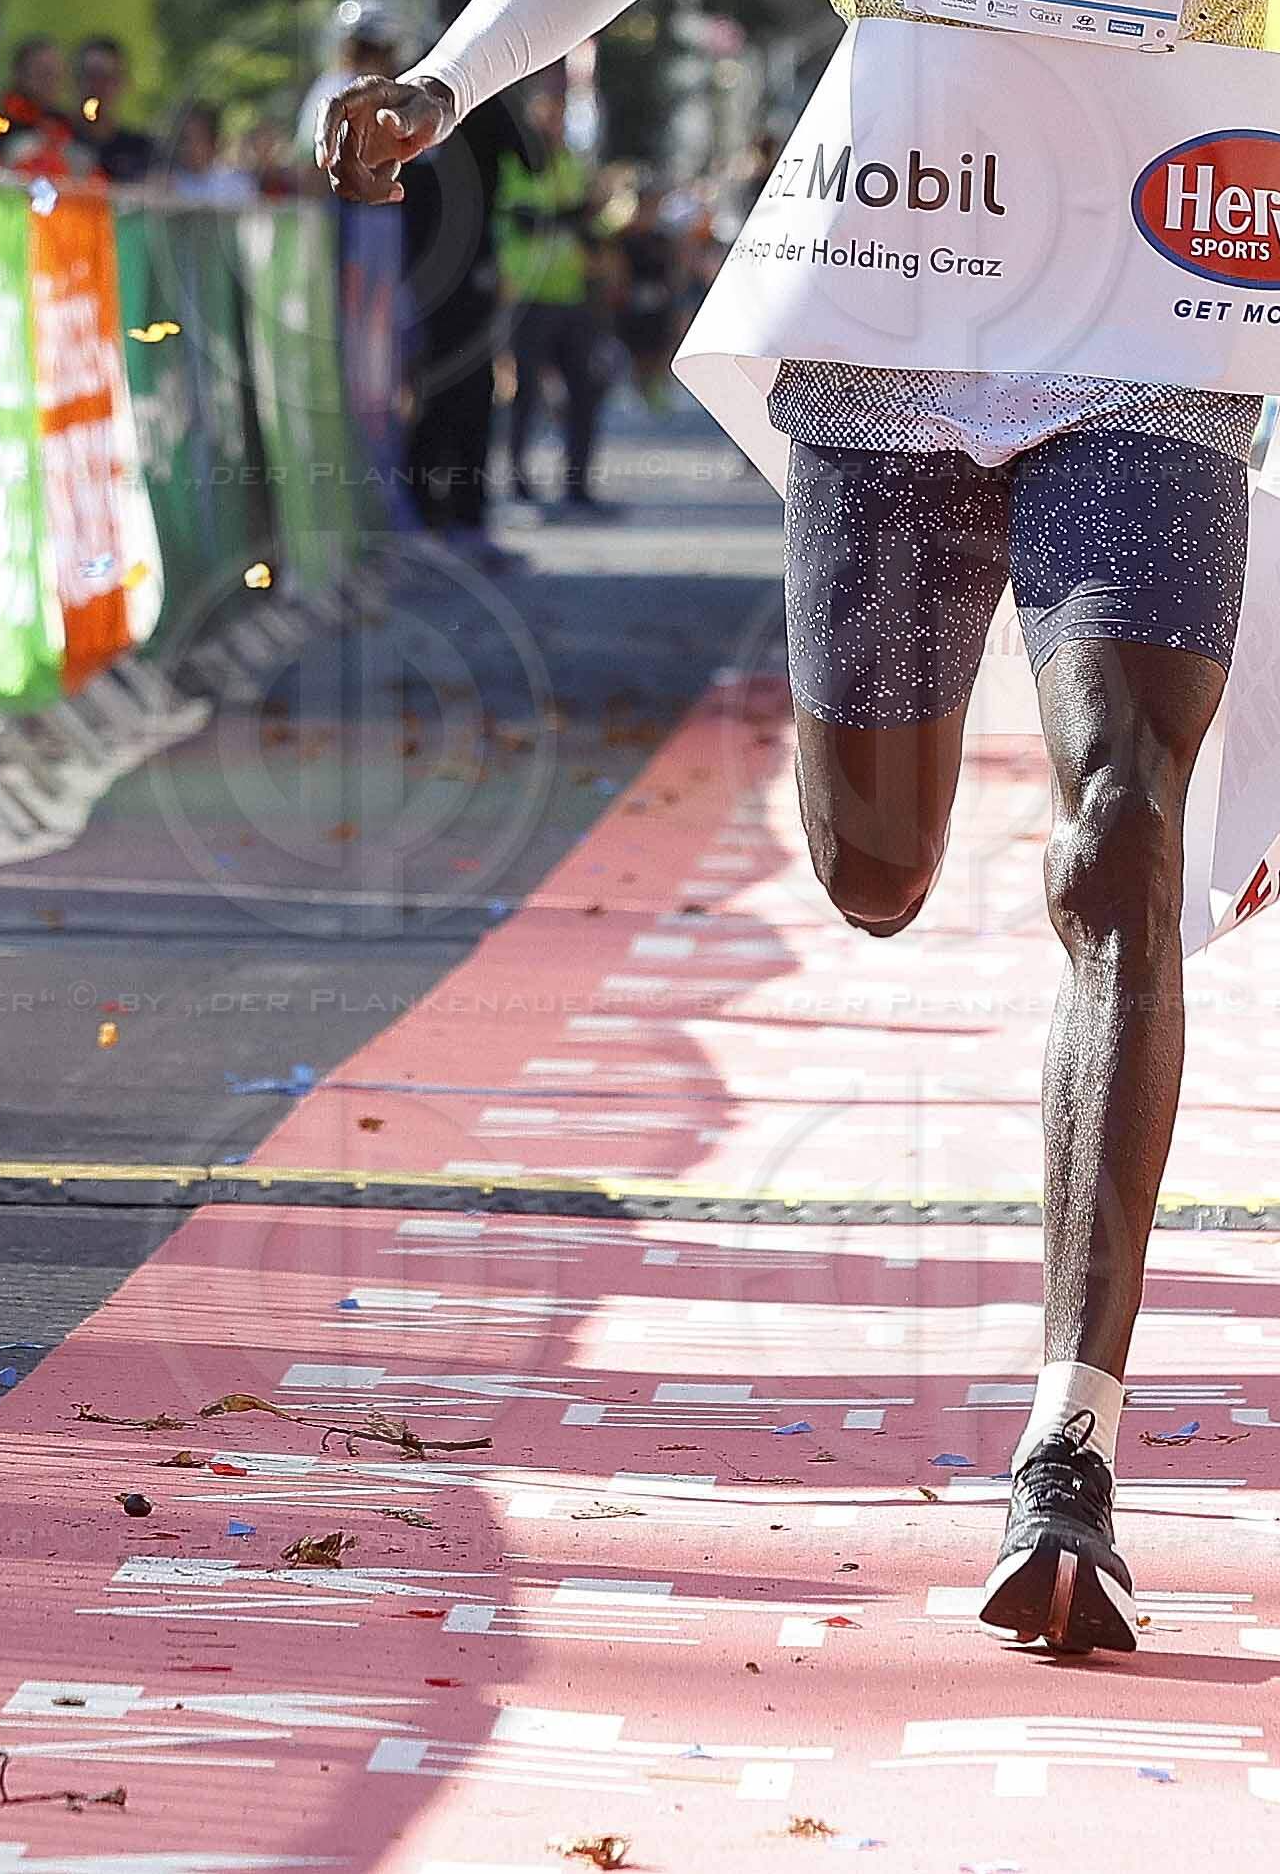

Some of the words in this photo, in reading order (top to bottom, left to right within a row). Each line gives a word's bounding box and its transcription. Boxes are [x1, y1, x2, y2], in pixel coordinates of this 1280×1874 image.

[775, 232, 805, 262] der
[811, 238, 920, 279] Holding
[930, 247, 1003, 277] Graz
[1190, 237, 1272, 261] SPORTS
[1173, 298, 1232, 322] GET
